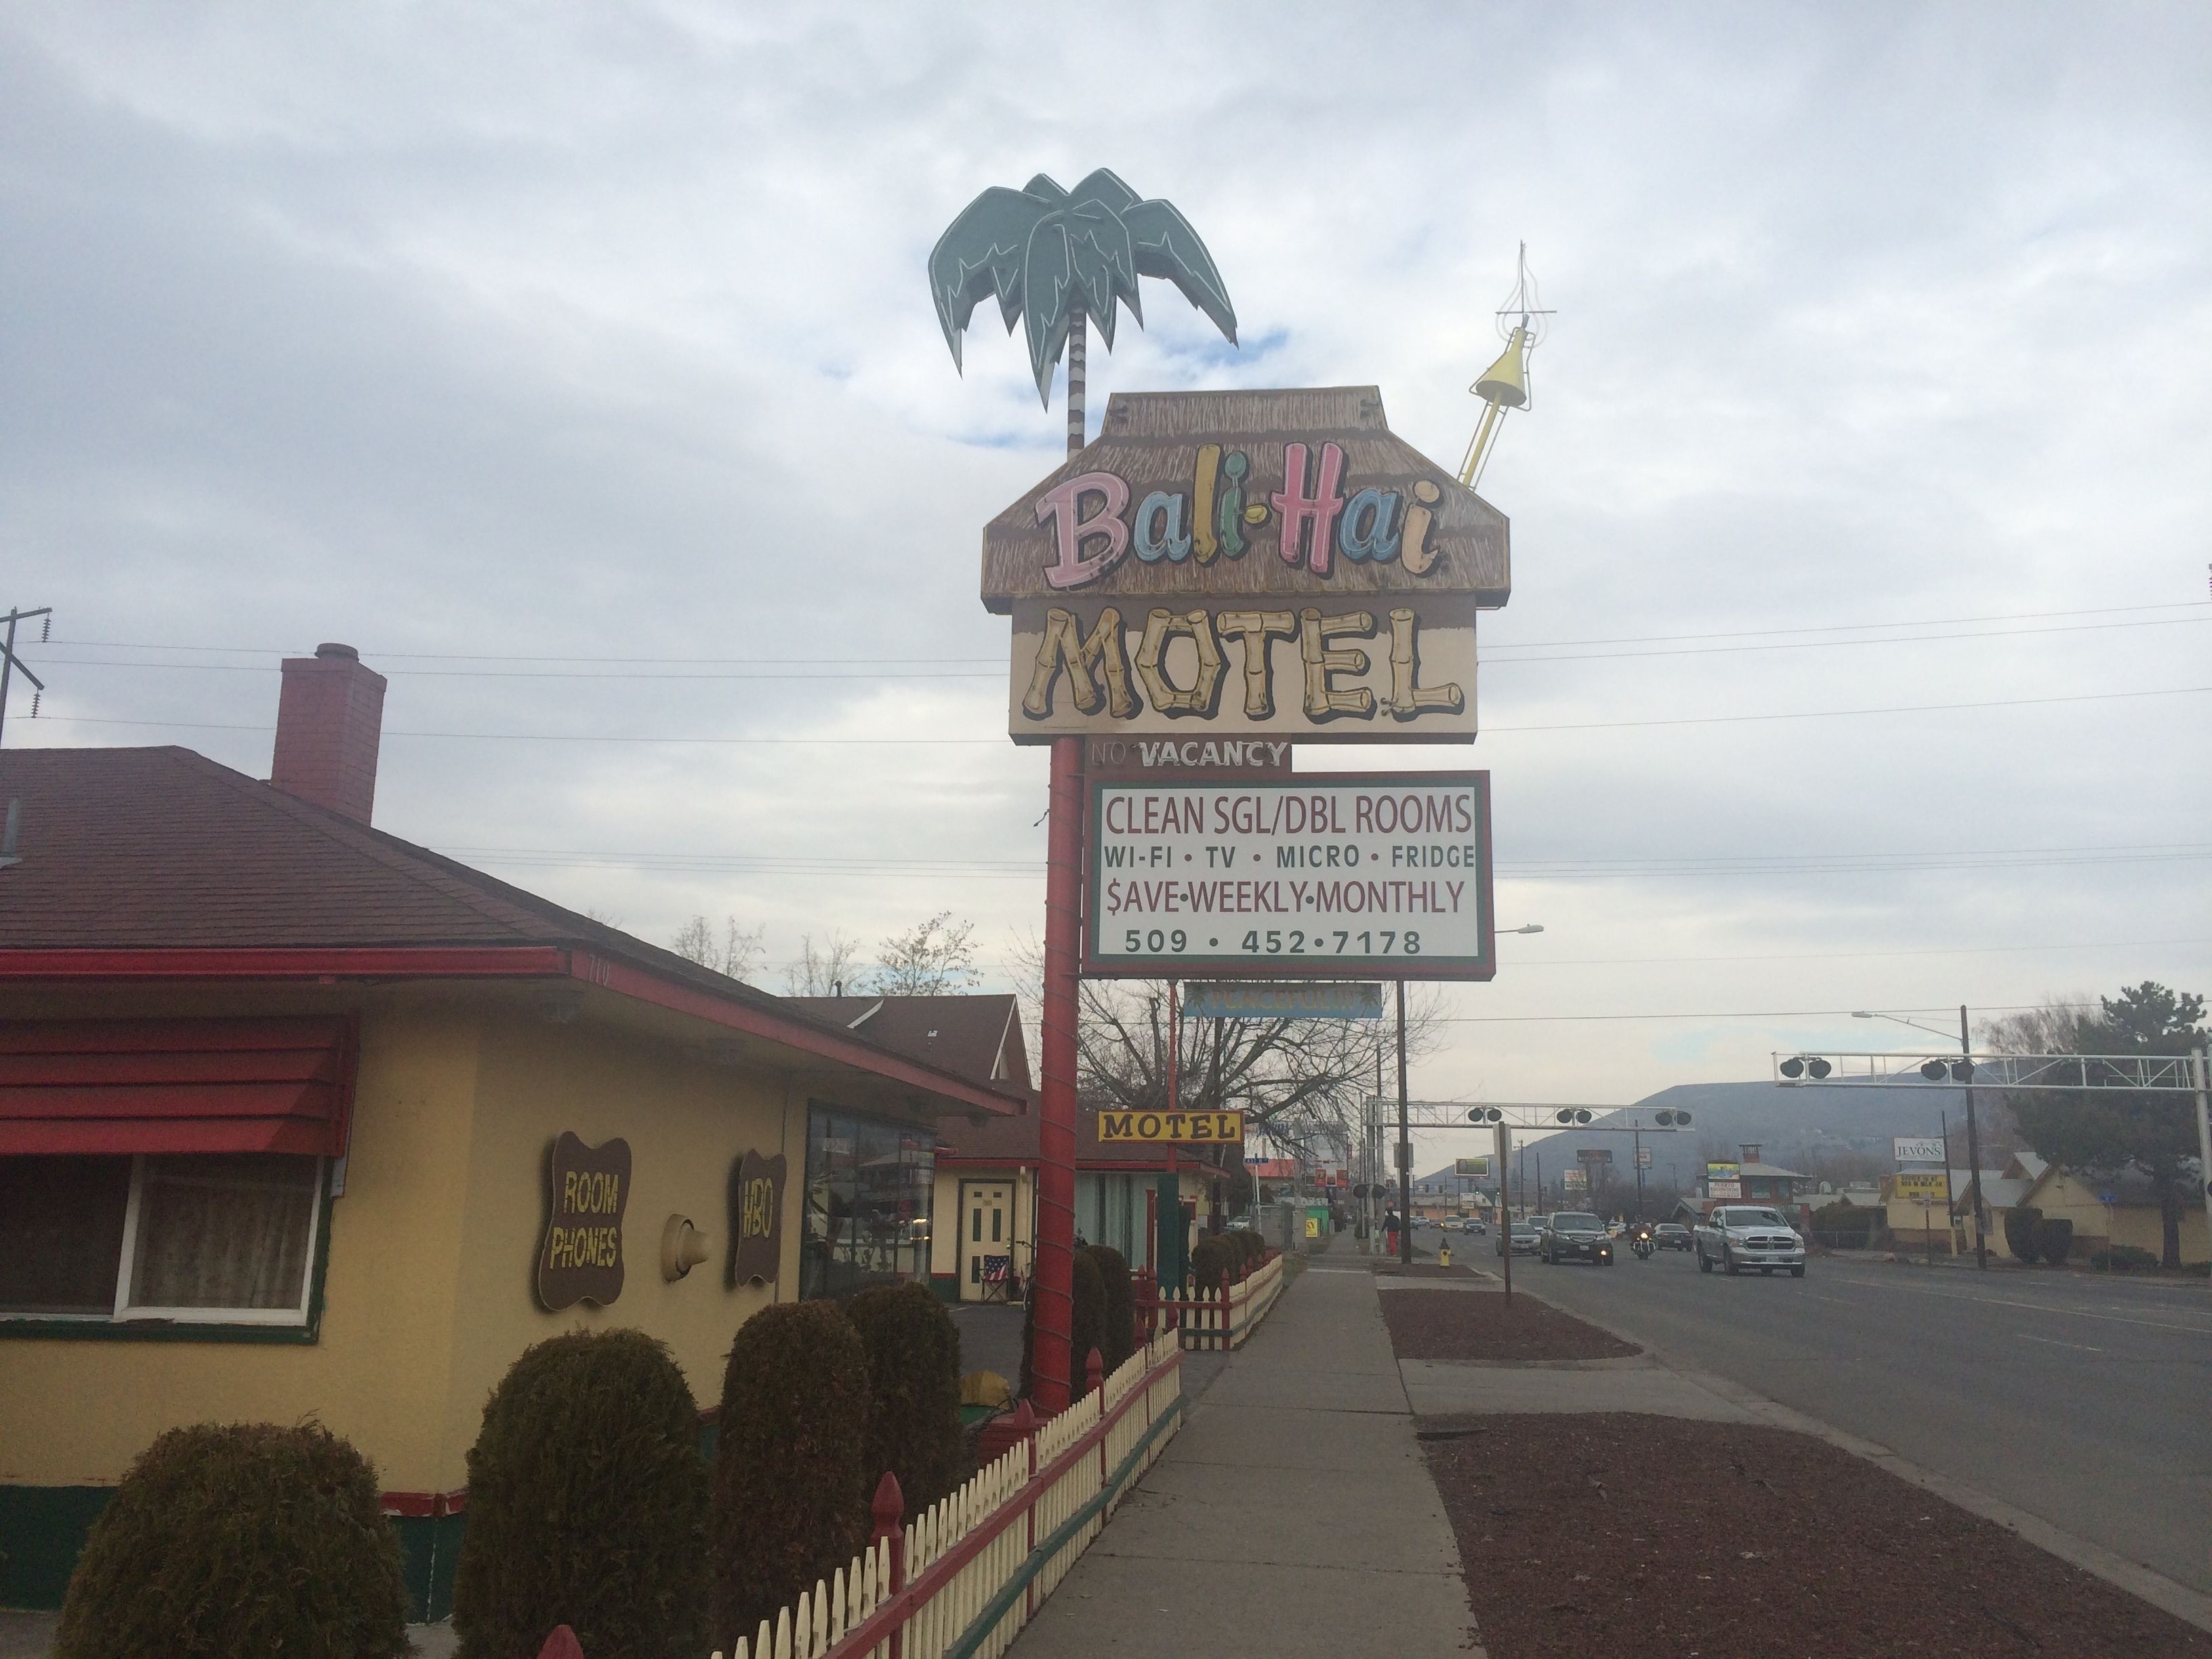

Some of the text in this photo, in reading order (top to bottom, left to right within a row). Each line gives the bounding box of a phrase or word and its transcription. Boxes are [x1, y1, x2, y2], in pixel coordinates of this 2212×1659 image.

[1022, 607, 1465, 722] MOTEL
[1091, 741, 1288, 767] NO VACANCY
[1105, 794, 1471, 836] CLEAN SGL/DBL ROOMS
[1104, 844, 1475, 867] WI-FI TV MICRO FRIDGE
[1188, 880, 1308, 913] WEEKLY
[1316, 880, 1465, 913] MONTHLY
[1125, 929, 1420, 954] 509 452 7178
[1103, 1114, 1235, 1139] MOTEL
[1897, 1147, 1940, 1157] JEVONS
[563, 1170, 618, 1214] ROOM
[743, 1177, 773, 1238] HBO
[550, 1226, 617, 1270] PHONES
